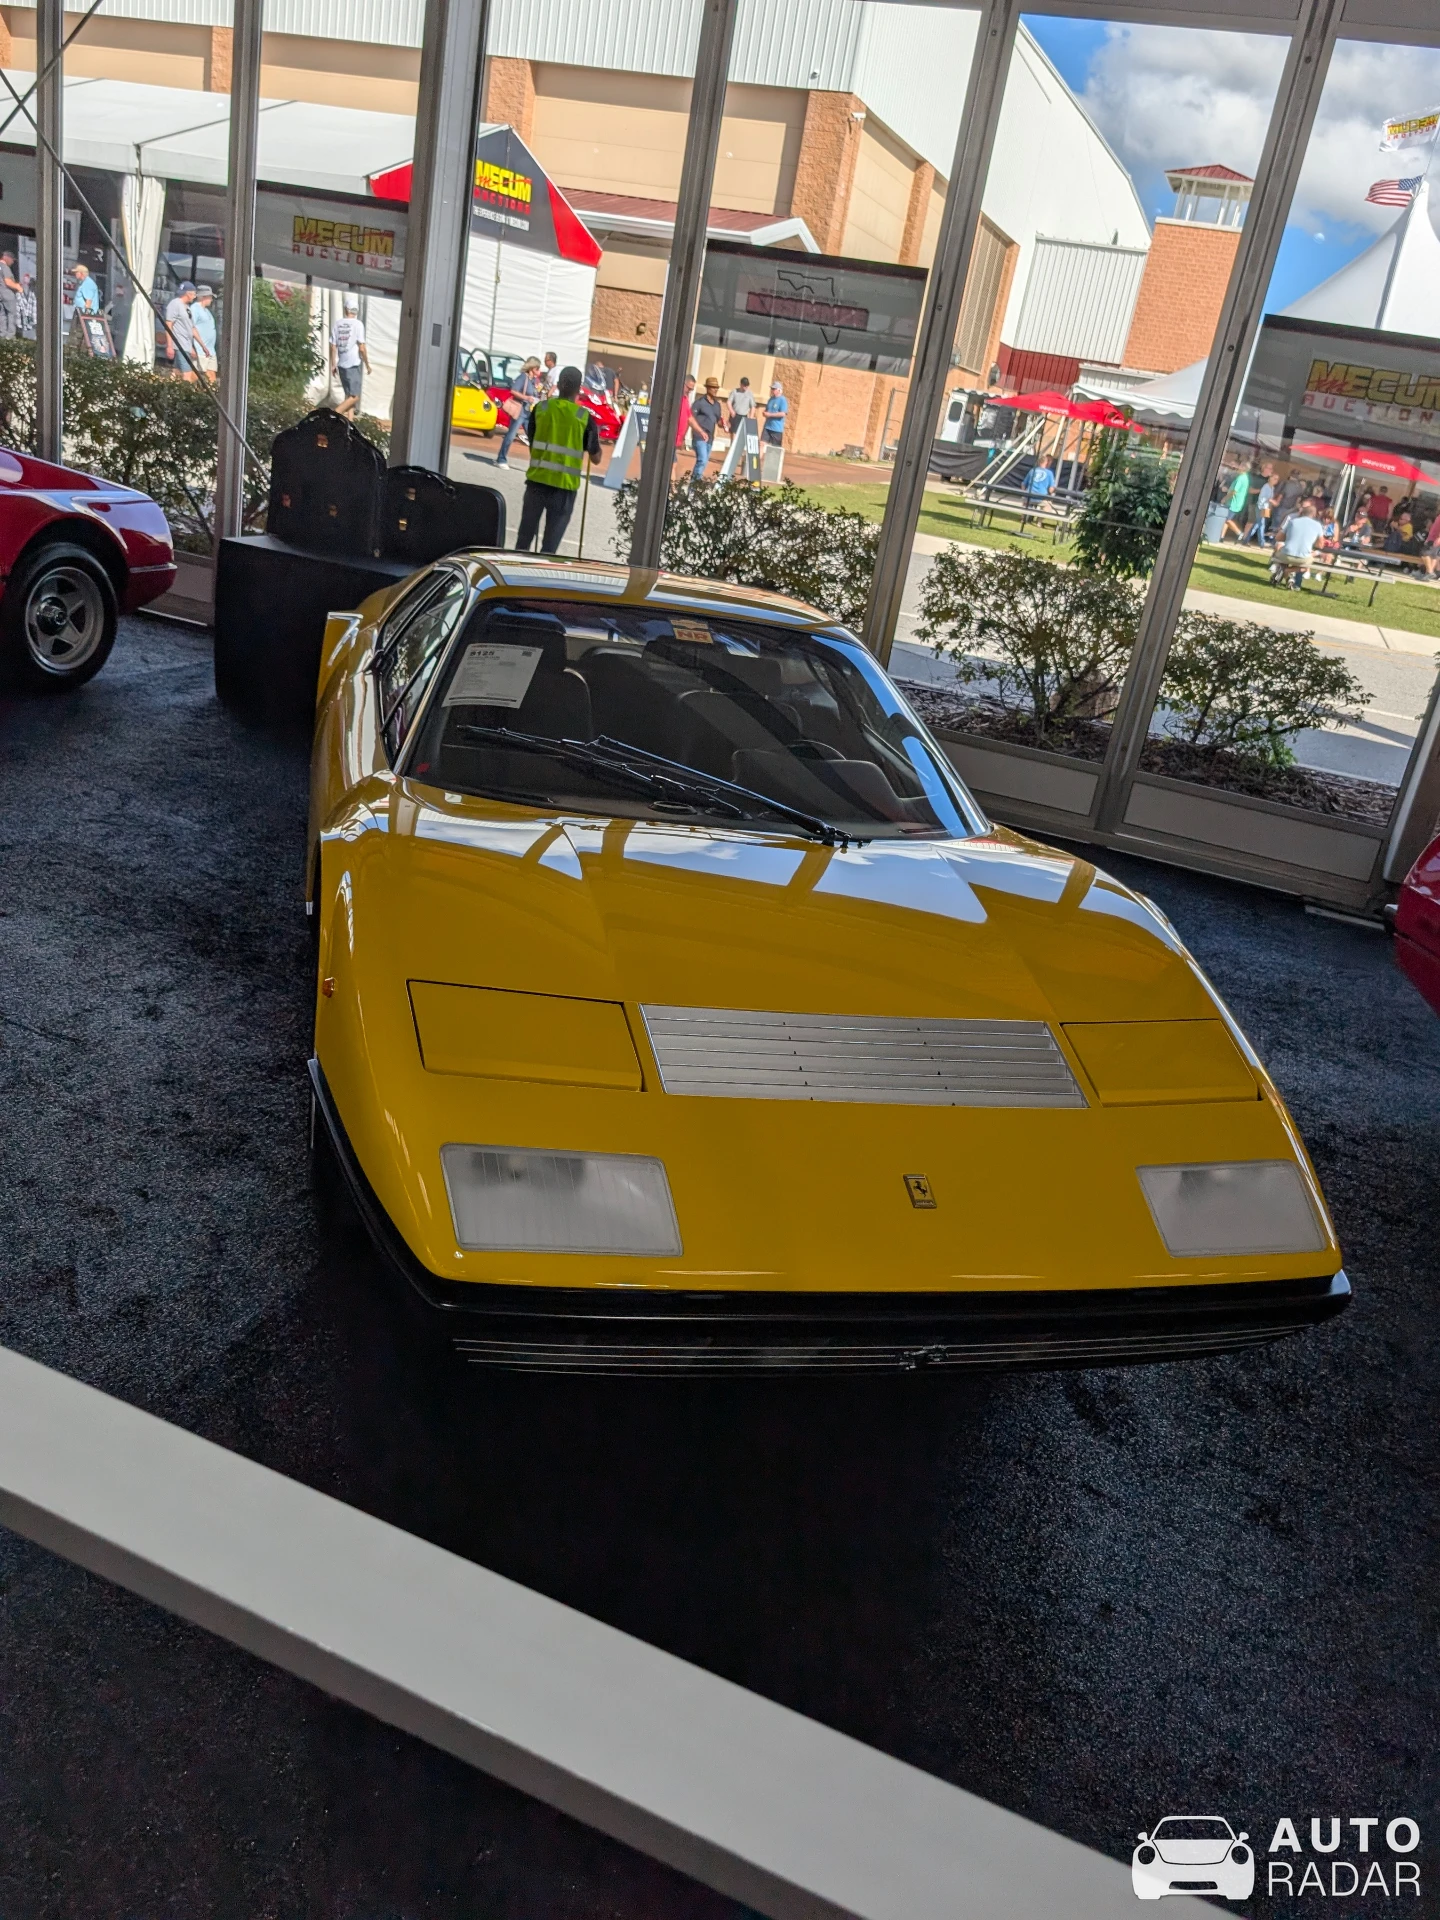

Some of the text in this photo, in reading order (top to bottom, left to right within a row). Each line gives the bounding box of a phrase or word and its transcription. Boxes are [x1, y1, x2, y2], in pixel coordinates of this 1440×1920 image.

[475, 159, 532, 203] MECUM
[473, 185, 531, 215] AUCTIONS
[293, 215, 395, 258] MECUM
[292, 244, 392, 270] AUCTIONS
[1302, 394, 1433, 423] AUCTION
